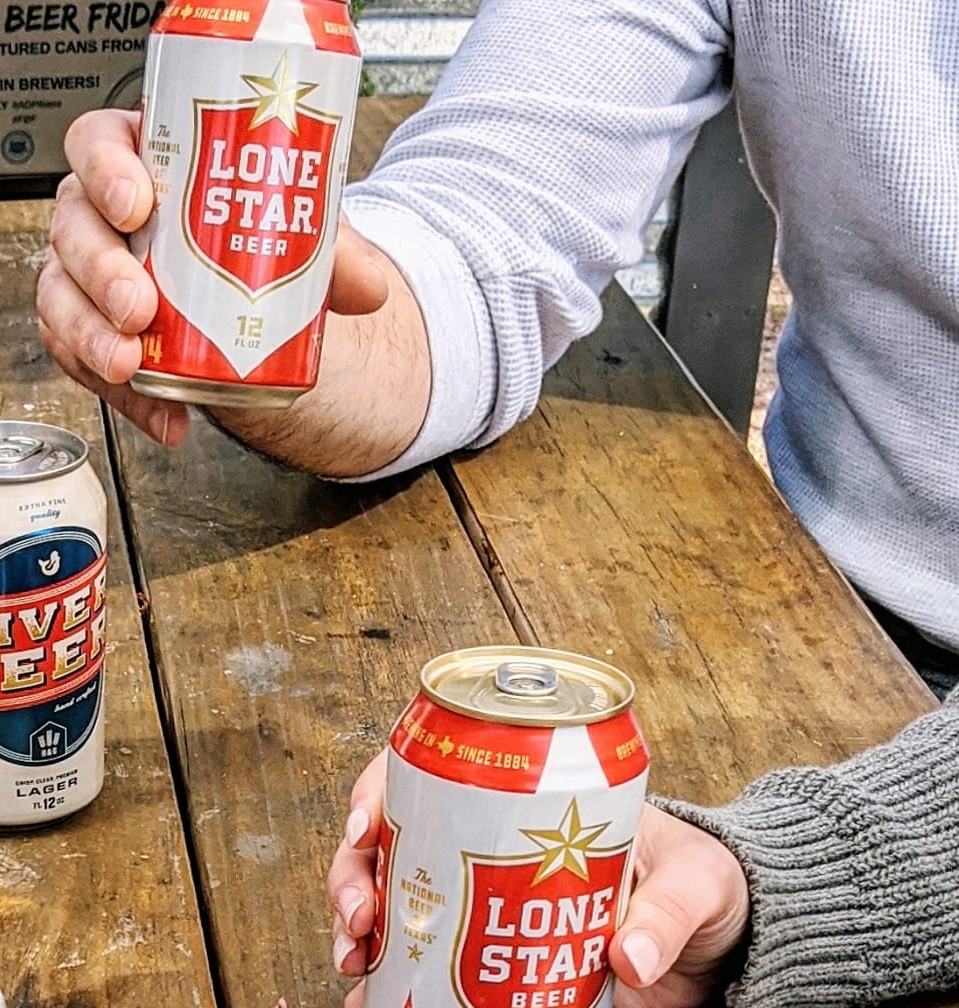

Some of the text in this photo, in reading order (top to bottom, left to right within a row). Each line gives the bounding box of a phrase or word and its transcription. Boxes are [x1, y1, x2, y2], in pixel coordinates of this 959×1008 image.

[4, 5, 80, 33] BEER
[193, 7, 221, 20] SINCE
[221, 9, 250, 23] 1884
[54, 40, 97, 54] CANS
[101, 38, 145, 52] FROM
[19, 76, 100, 90] BREWERS!
[210, 140, 322, 189] LONE
[229, 234, 288, 256] BEER
[236, 315, 263, 338] 12
[235, 338, 245, 348] FL
[455, 744, 491, 766] SINCE
[494, 751, 530, 771] 1884
[16, 777, 78, 797] LAGER
[43, 796, 56, 810] 12
[414, 867, 432, 885] The
[484, 886, 614, 938] LONE
[511, 987, 577, 1008] BEER
